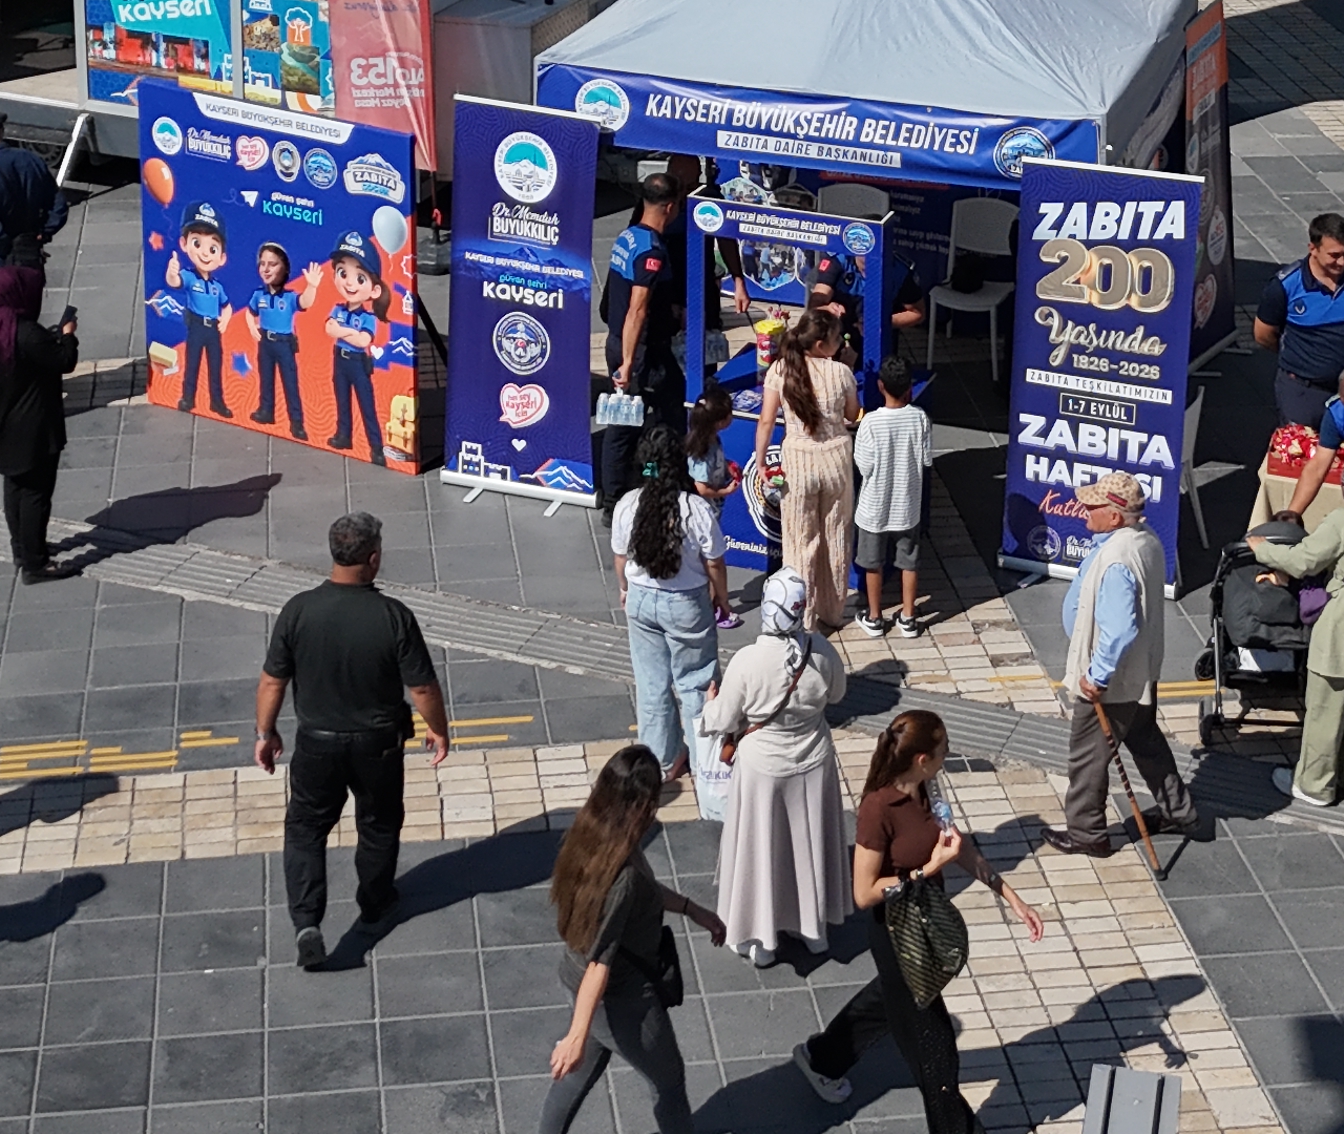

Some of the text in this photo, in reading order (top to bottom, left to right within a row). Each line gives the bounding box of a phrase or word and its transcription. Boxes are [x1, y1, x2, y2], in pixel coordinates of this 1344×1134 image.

[645, 93, 731, 125] KAYSERİ
[732, 102, 858, 141] BÜYÜKŞEHİR
[859, 118, 979, 155] BELEDİYESİ
[724, 133, 894, 166] ZABITA DAİRE BAŞKANLIĞI
[354, 172, 397, 190] ZABITA
[1031, 200, 1185, 240] ZABITA
[1036, 237, 1175, 313] 200
[1034, 306, 1167, 366] Yaşında
[1030, 371, 1069, 387] ZABITA
[1072, 354, 1160, 379] 1826-2026
[1068, 398, 1127, 420] 1-7 EYLÜL
[1018, 413, 1175, 470] ZABITA
